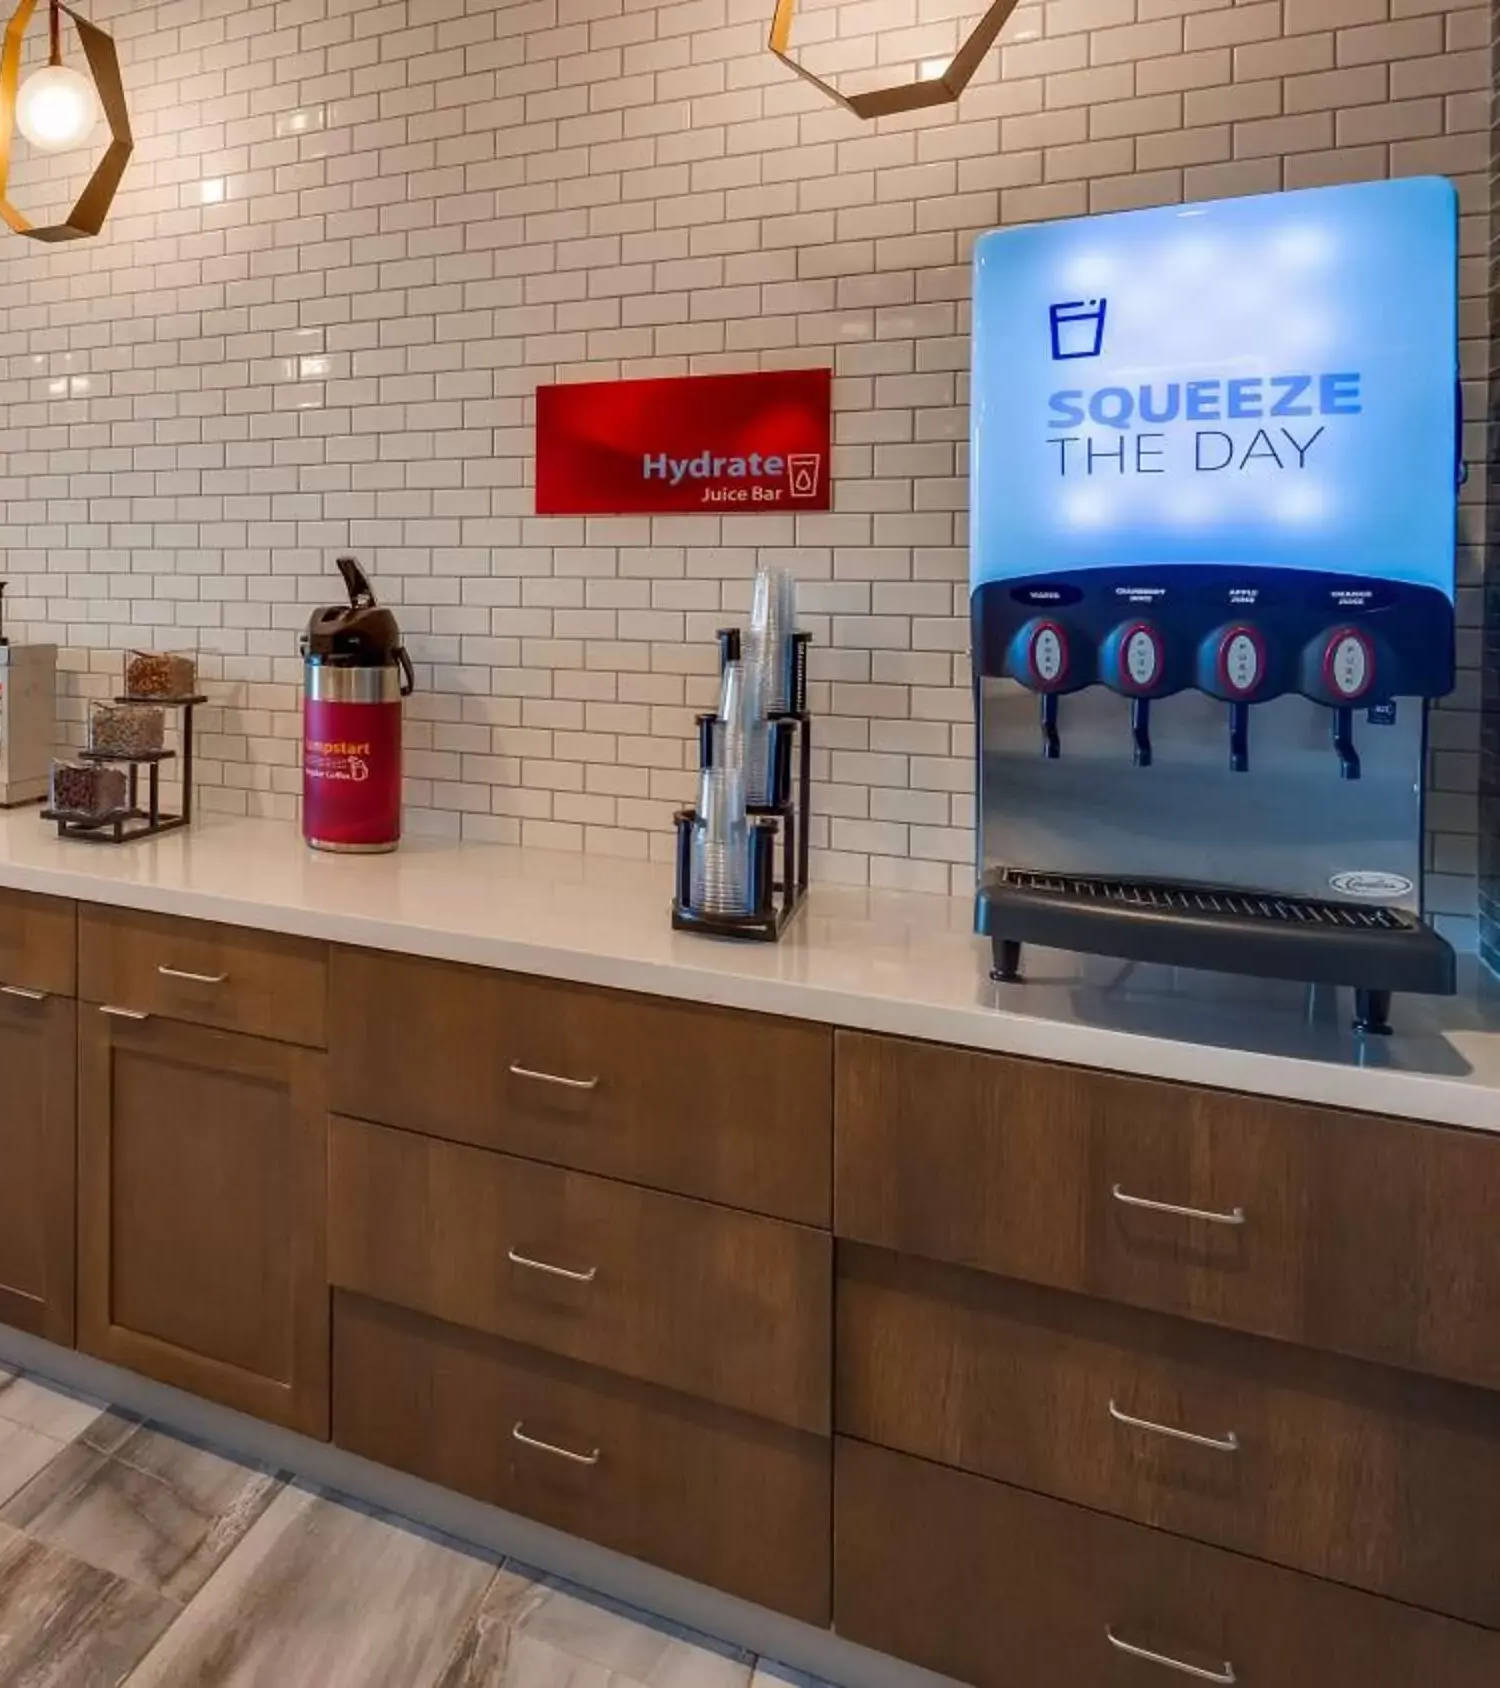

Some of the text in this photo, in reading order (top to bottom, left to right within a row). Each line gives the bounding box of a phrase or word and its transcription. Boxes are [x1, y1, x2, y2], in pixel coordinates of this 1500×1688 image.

[1047, 372, 1363, 429] SQUEEZE
[643, 450, 784, 486] Hydrate
[1045, 425, 1325, 476] THE DAY
[701, 485, 783, 502] Juice Bar
